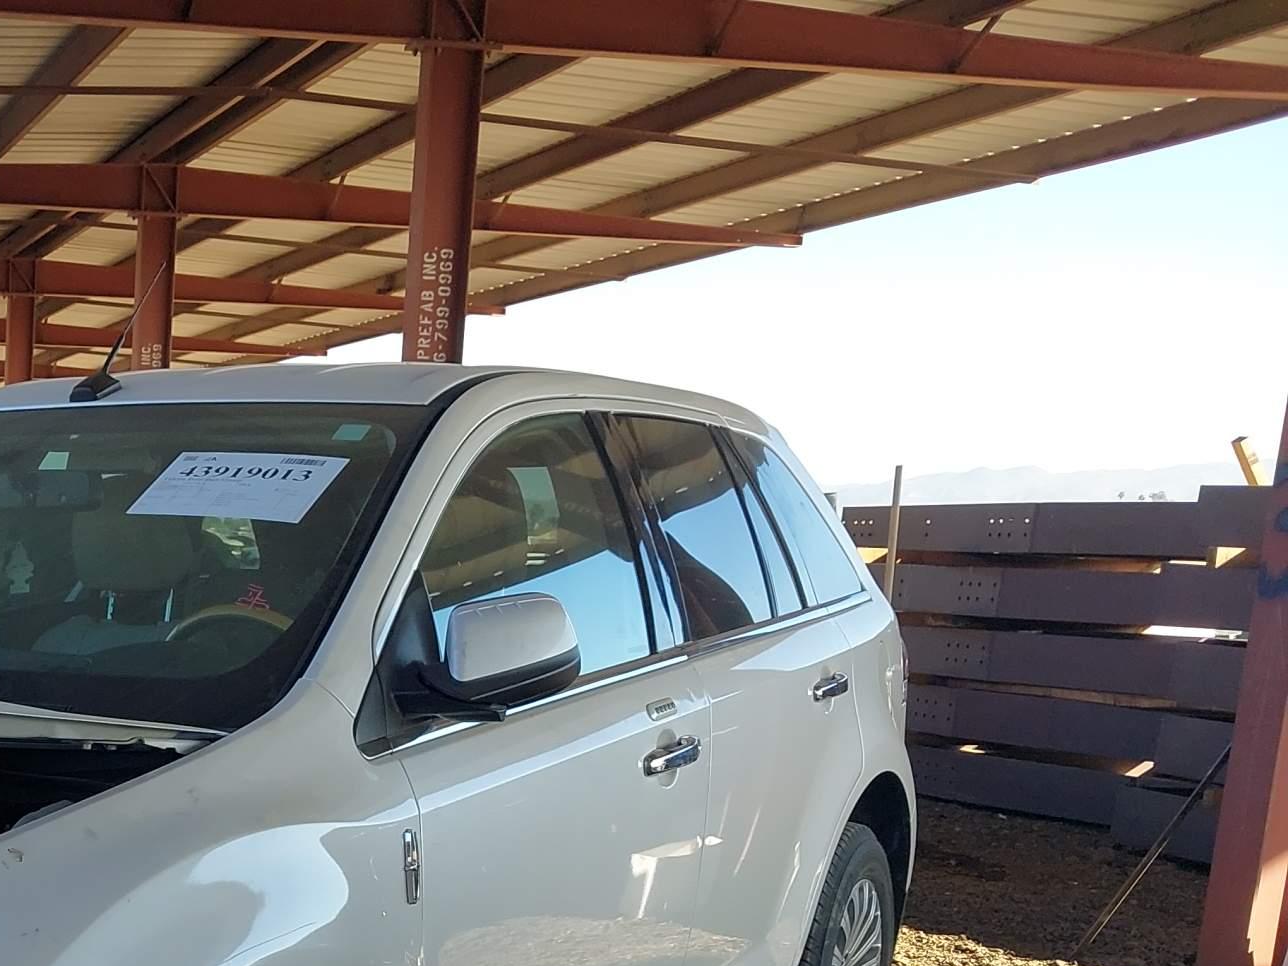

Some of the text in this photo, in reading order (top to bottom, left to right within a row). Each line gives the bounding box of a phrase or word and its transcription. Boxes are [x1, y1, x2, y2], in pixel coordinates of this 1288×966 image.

[417, 246, 438, 360] PREFAB INC.
[141, 343, 152, 365] INC.
[179, 465, 312, 482] 43919013
